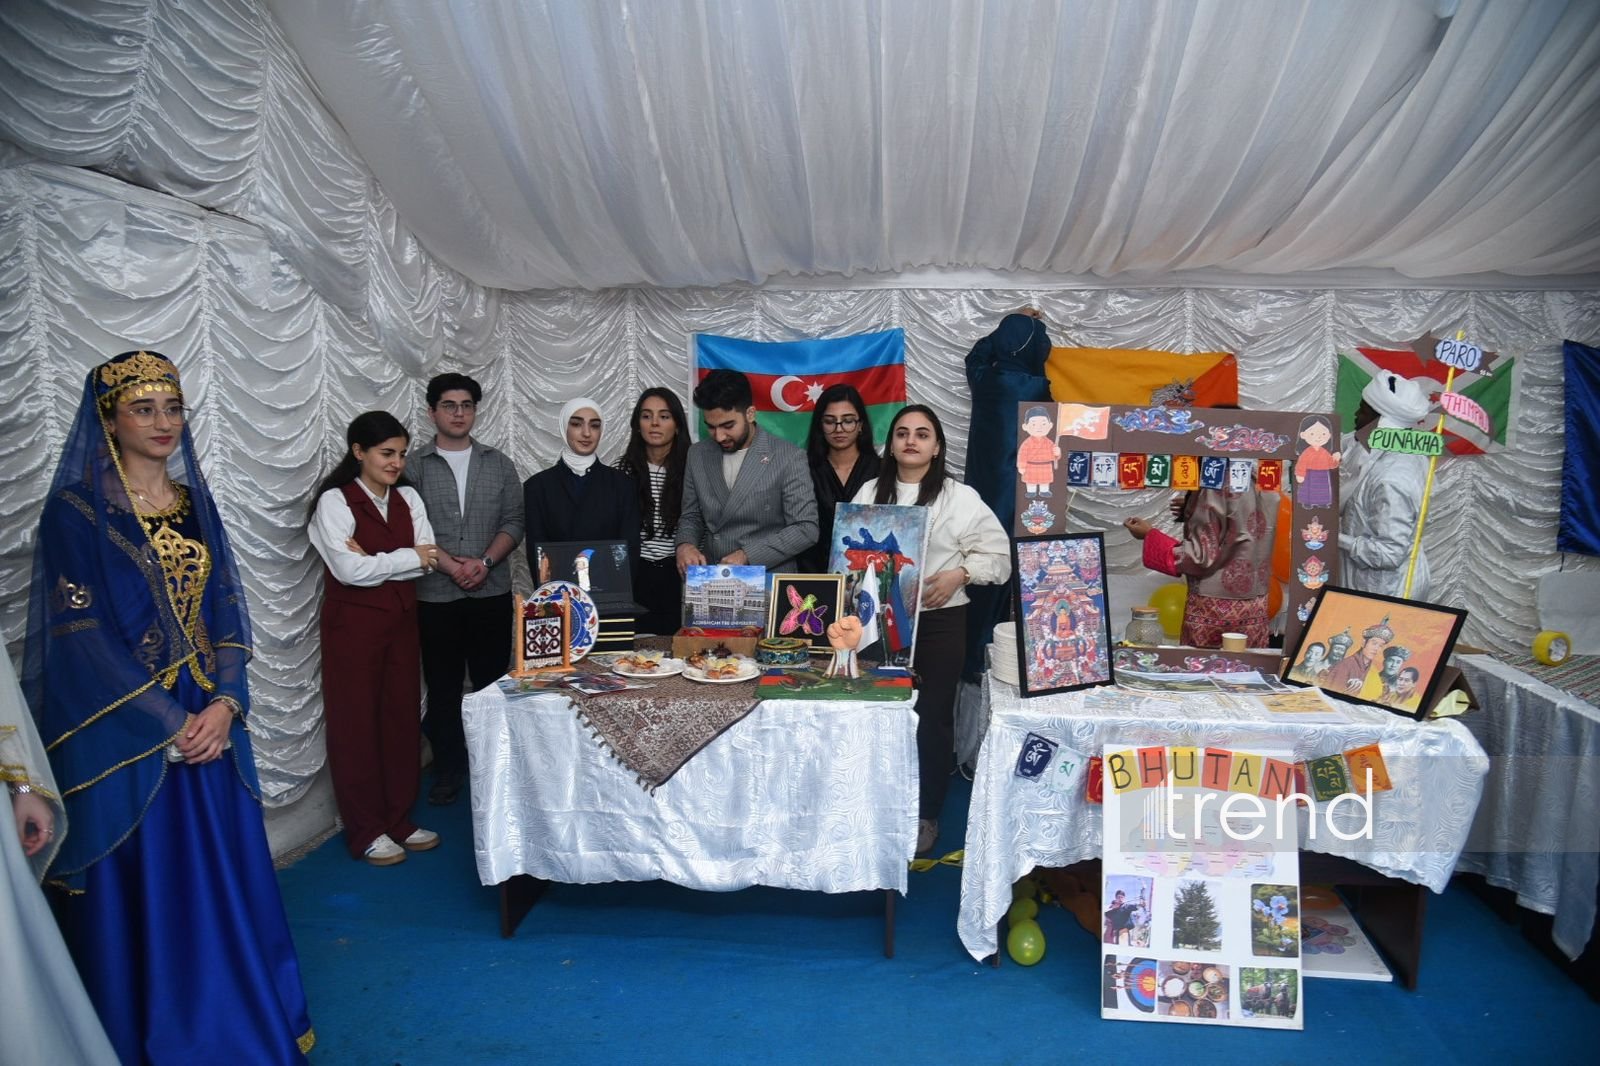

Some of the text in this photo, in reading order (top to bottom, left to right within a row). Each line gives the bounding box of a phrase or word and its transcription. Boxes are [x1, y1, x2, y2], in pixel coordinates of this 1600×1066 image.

[1438, 340, 1477, 368] PARO
[1371, 429, 1440, 454] PUNAKHA
[1108, 751, 1292, 796] BHUTAN
